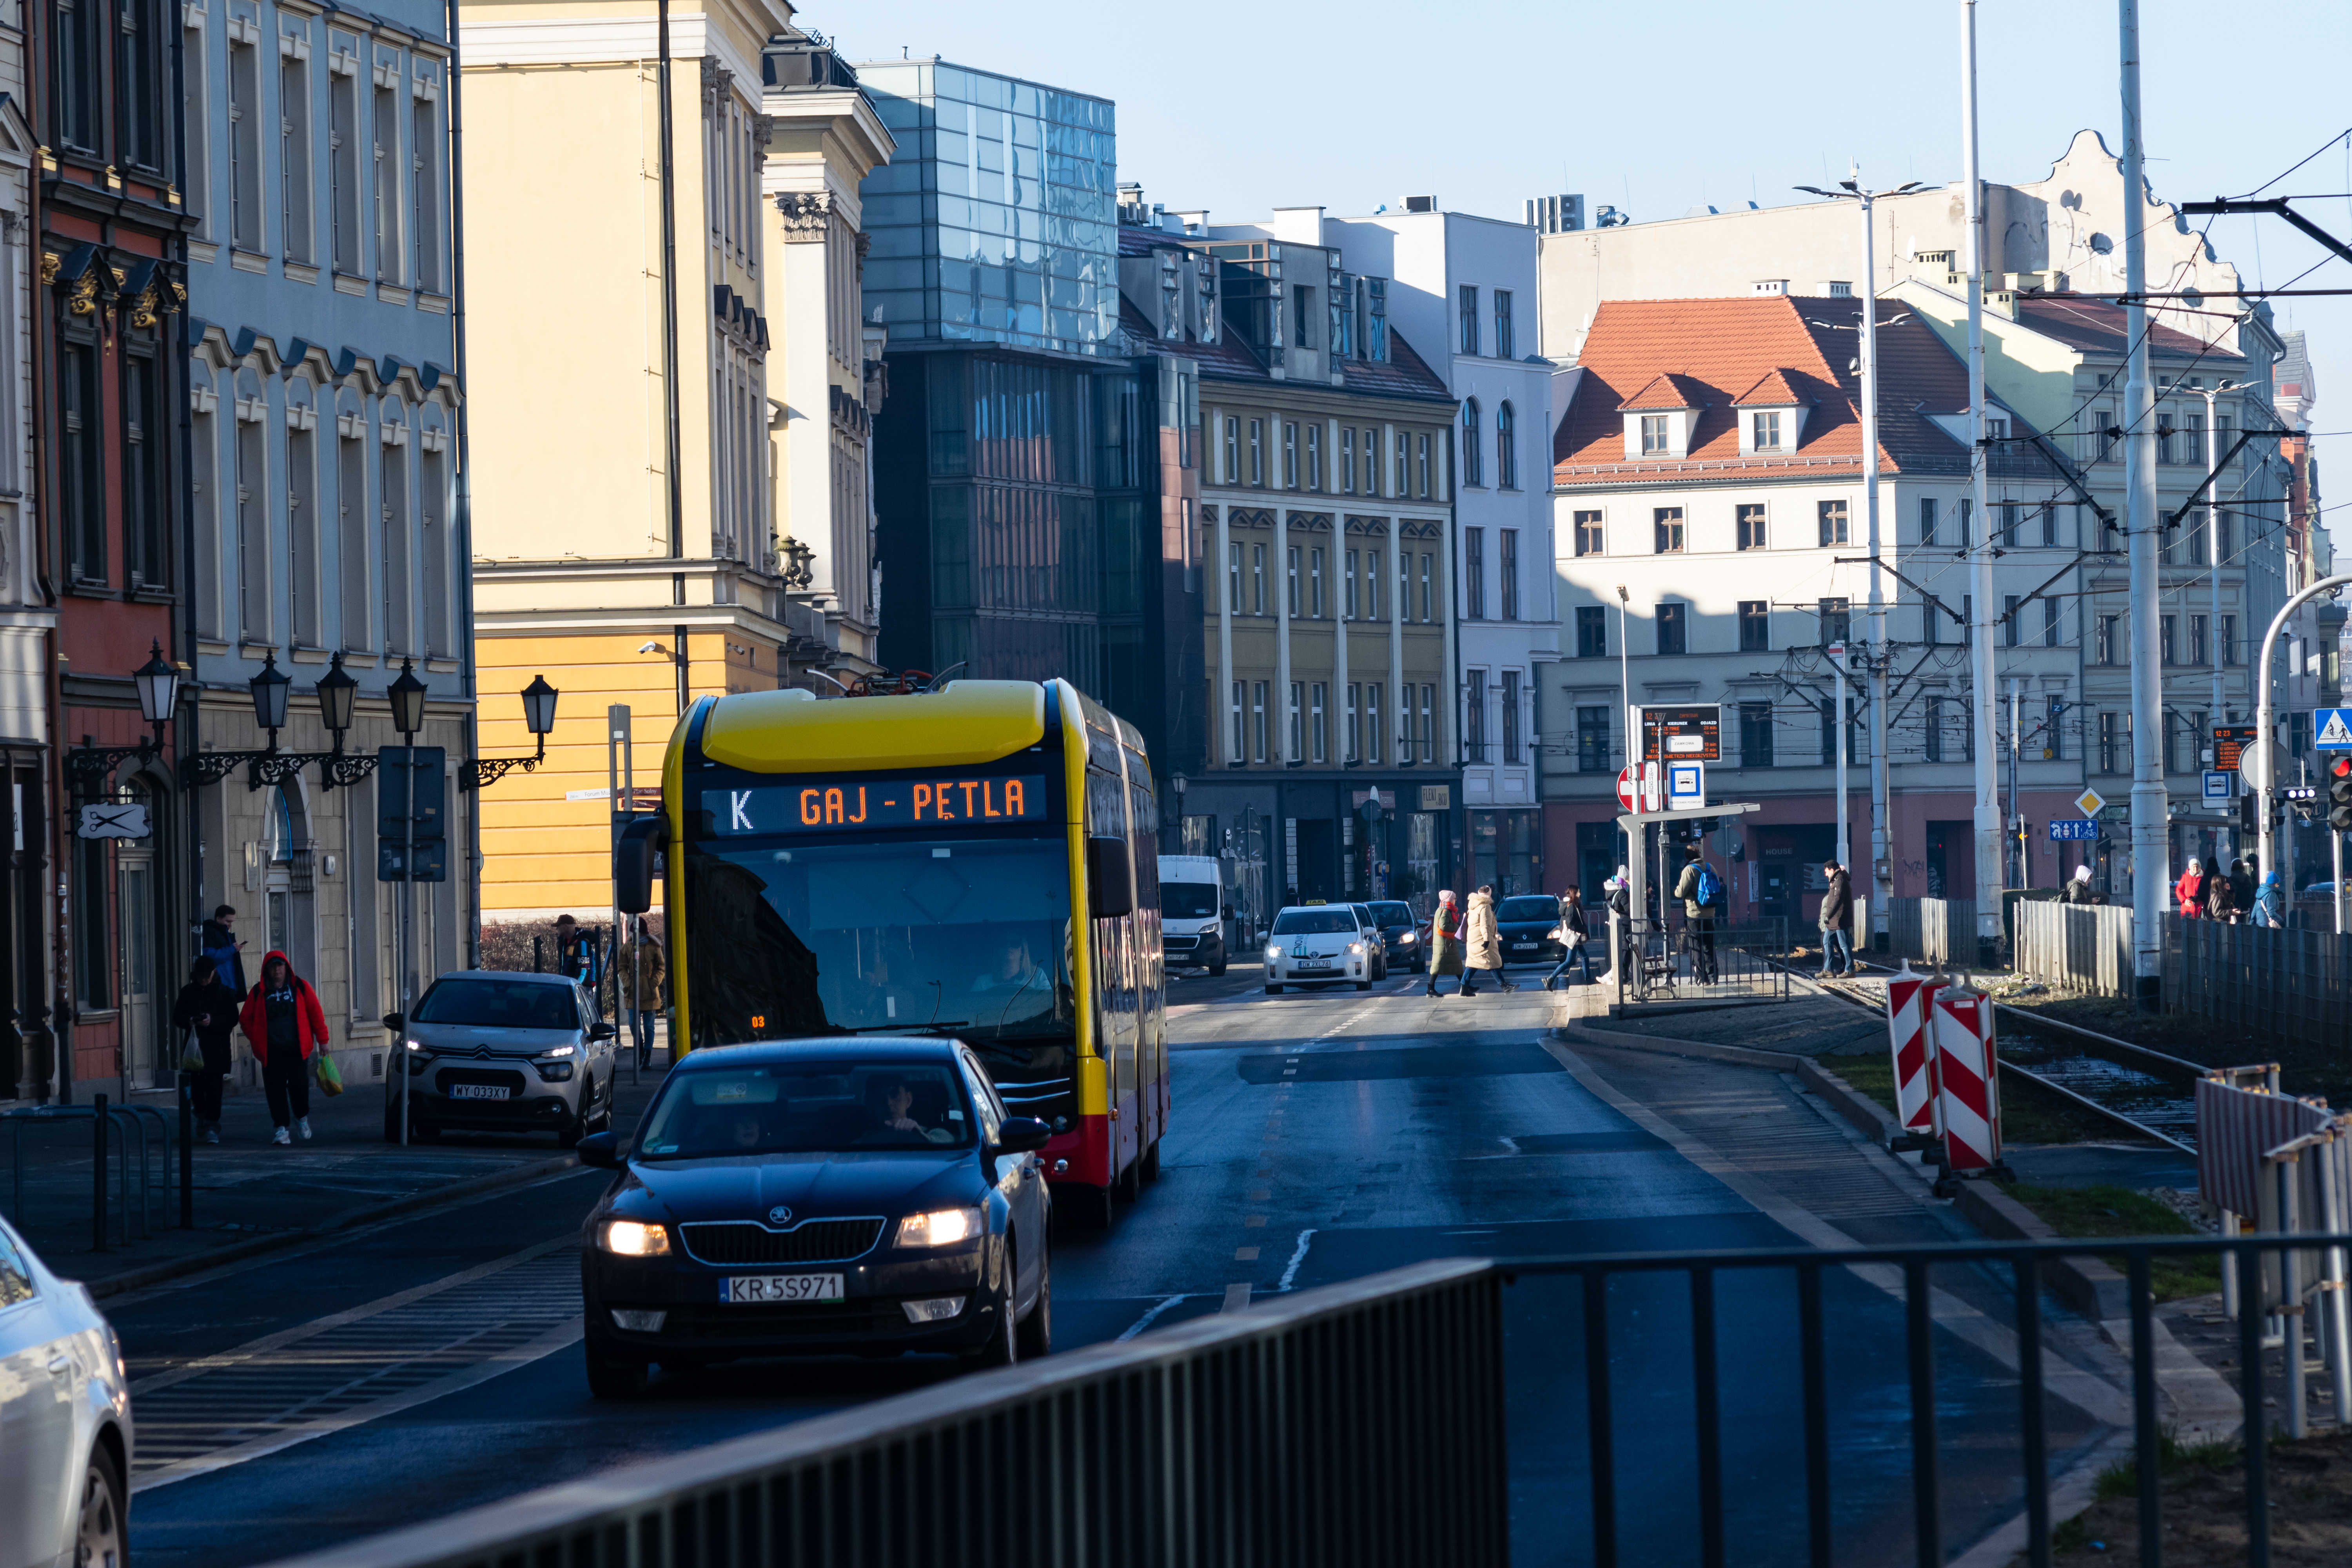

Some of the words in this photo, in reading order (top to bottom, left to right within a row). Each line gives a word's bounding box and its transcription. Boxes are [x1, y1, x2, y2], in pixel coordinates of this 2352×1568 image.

[1423, 788, 1436, 801] FLEKI
[732, 791, 753, 830] K
[800, 787, 866, 824] GAJ
[913, 780, 1024, 820] PĘTLA
[752, 1016, 764, 1028] 03
[456, 1085, 470, 1096] WY
[474, 1087, 507, 1098] 033XY
[732, 1279, 764, 1301] KR
[772, 1276, 836, 1299] 5S971
